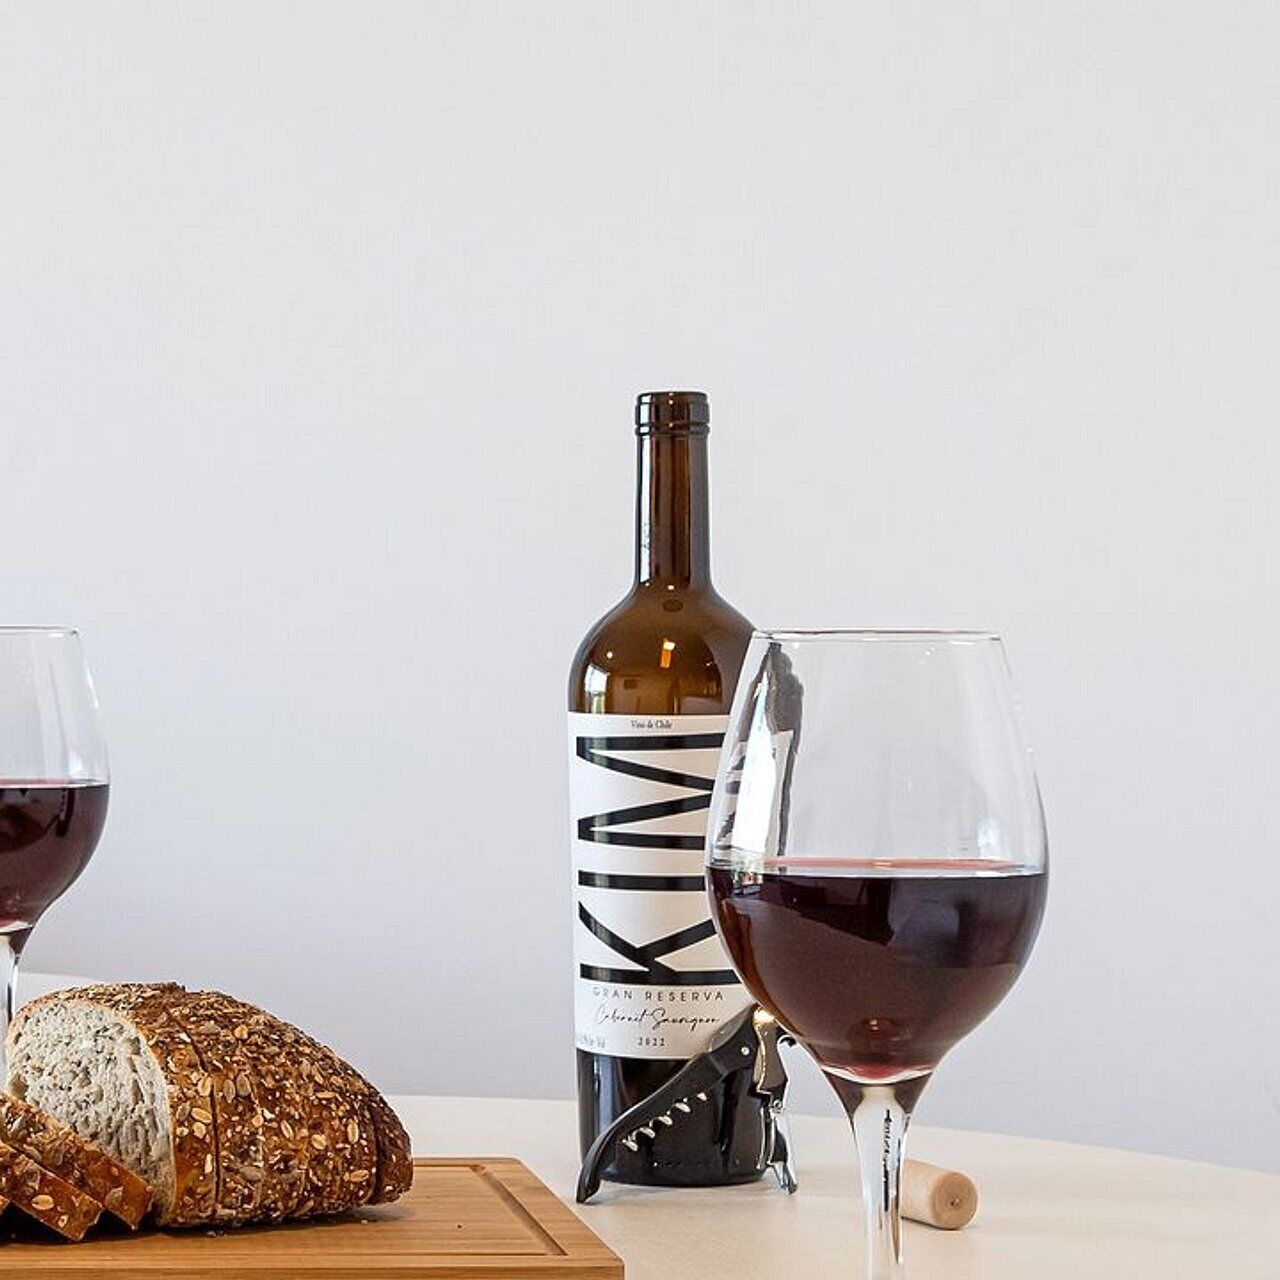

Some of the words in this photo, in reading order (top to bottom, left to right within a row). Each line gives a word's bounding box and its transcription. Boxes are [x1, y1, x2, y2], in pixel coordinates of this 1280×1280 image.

[593, 987, 633, 999] GRAN
[645, 991, 724, 1002] RESERVA
[596, 1004, 648, 1024] Cabernet
